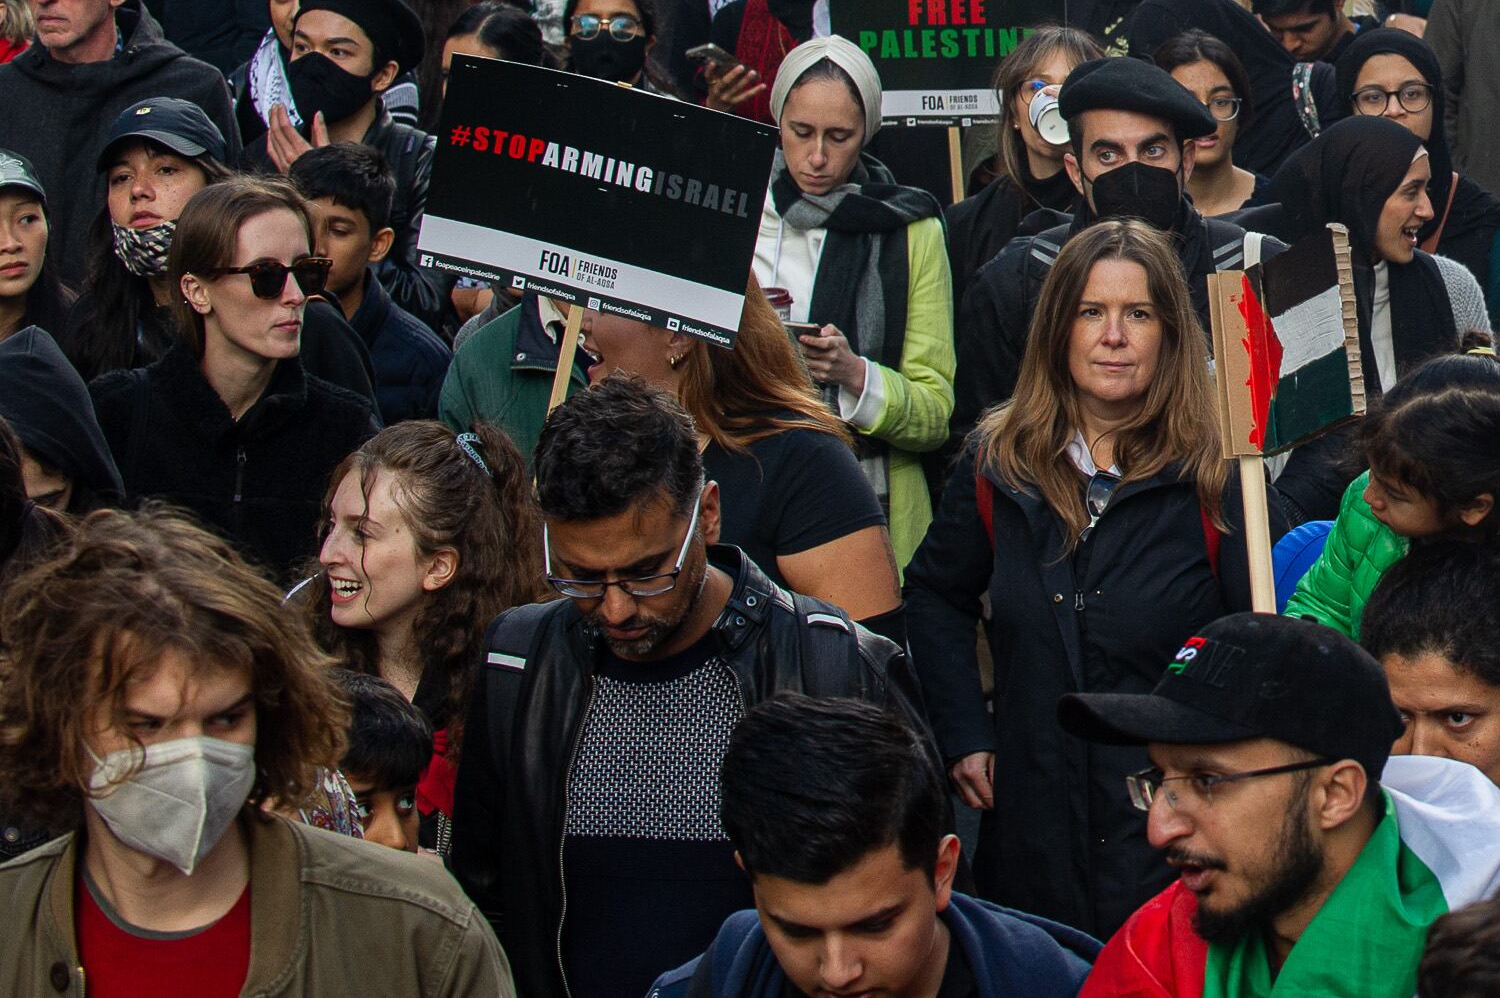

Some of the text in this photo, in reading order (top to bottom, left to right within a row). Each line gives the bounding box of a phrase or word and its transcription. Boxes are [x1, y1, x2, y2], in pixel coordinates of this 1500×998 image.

[922, 96, 945, 110] FOA
[949, 95, 978, 103] FRIENDS
[451, 125, 748, 218] #STOPARMINGISRAEL
[539, 250, 618, 281] FOA FRIENDS
[576, 272, 616, 290] OF AL-AQSA
[435, 260, 731, 345] foapeaceinpalestine friendsofalaqsa friendsofalaqsa friendsofalaqsa
